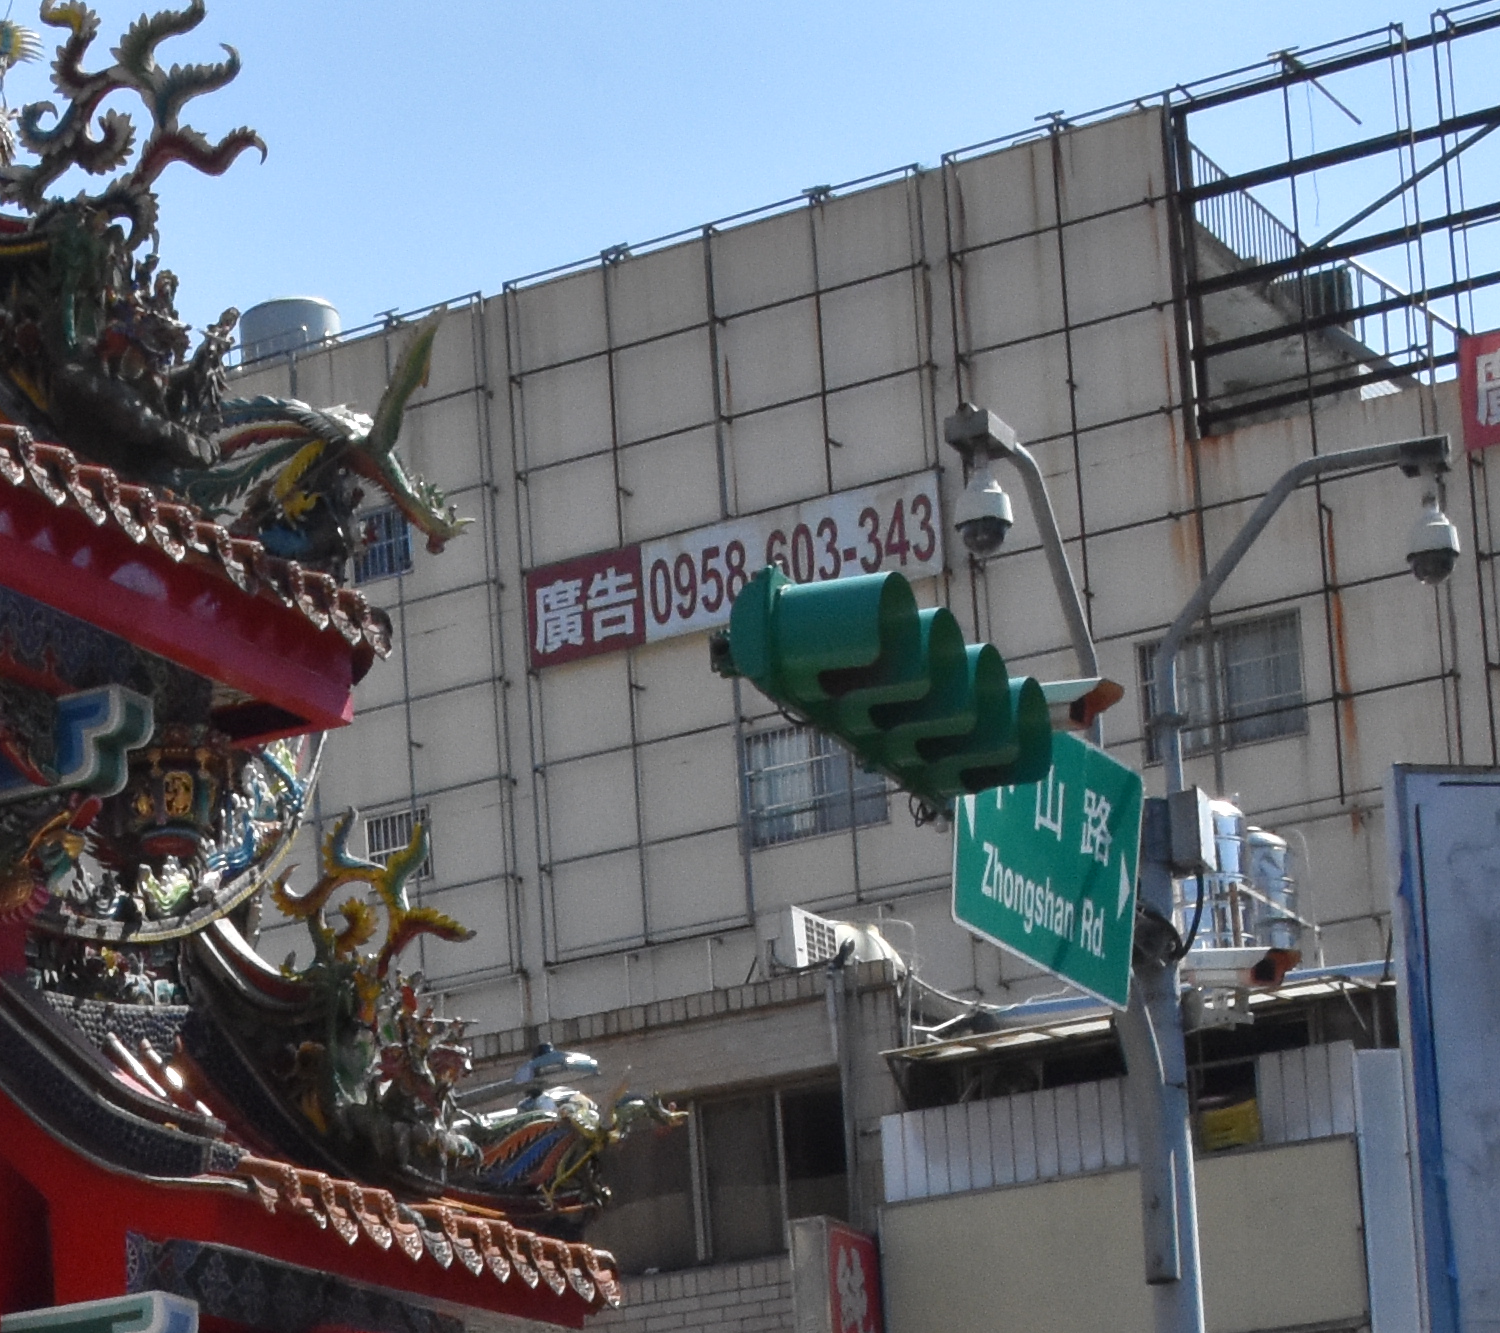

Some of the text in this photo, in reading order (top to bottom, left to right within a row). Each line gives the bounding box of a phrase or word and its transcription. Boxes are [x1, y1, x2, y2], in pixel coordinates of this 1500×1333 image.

[534, 493, 937, 653] 廣告 0958-603-343
[996, 764, 1112, 867] 山路
[981, 842, 1106, 958] Zhongshan Rd.
